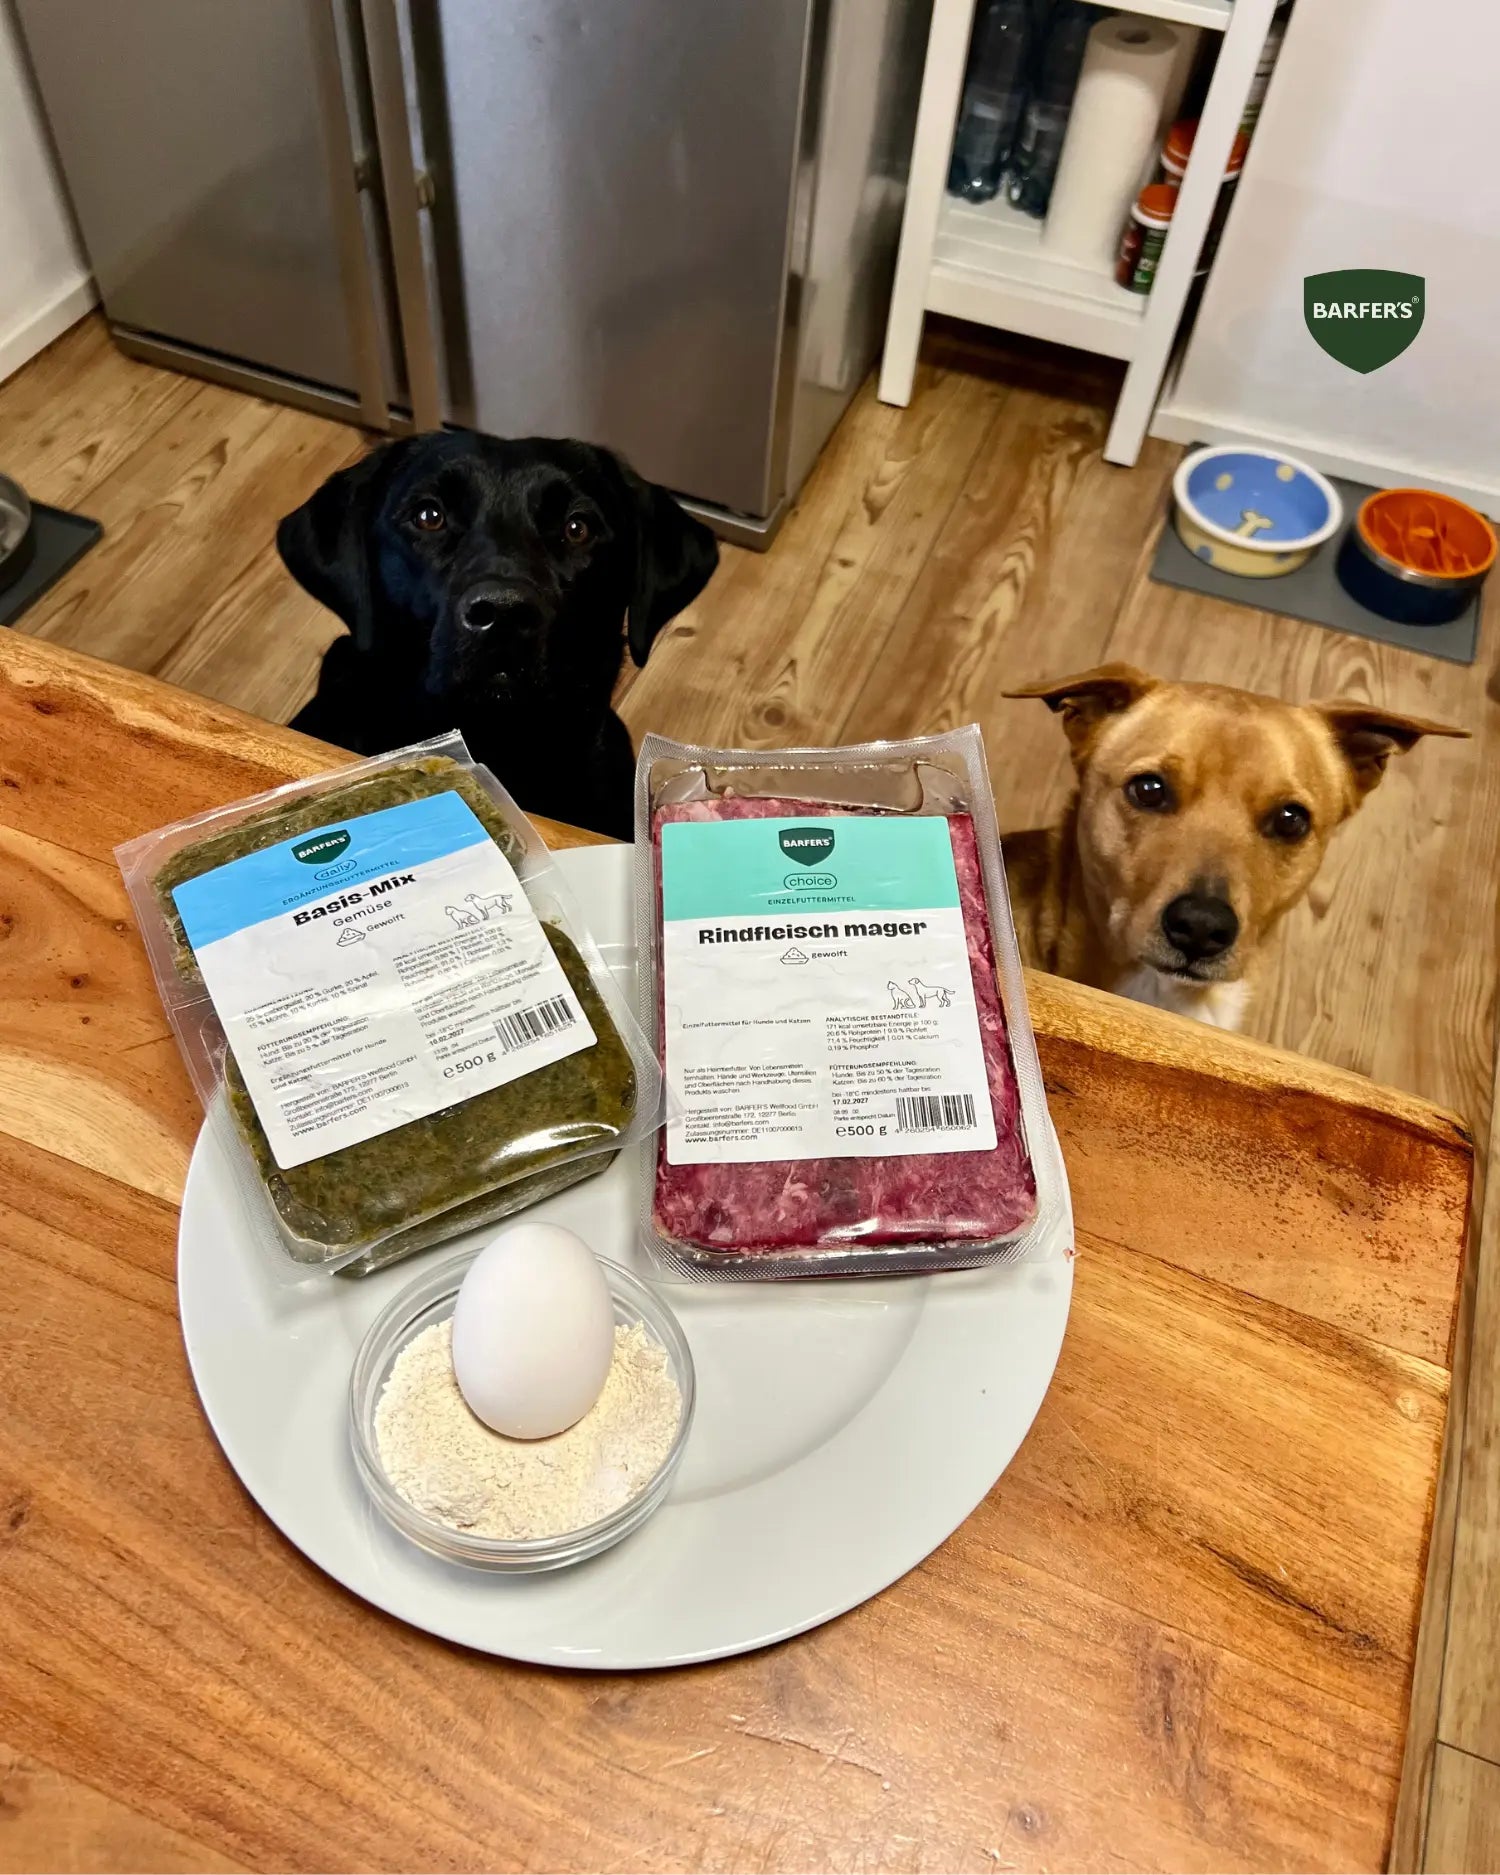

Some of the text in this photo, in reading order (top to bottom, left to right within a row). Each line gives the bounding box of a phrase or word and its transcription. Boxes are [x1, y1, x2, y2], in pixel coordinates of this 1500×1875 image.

[298, 837, 346, 859] BARFER'S
[783, 838, 830, 848] BARFER'S
[318, 862, 353, 882] daily
[789, 876, 832, 887] choice
[294, 875, 415, 926] Basis-Mix
[768, 896, 856, 905] EINZELFUTTERMITTEL
[332, 900, 392, 927] Gemüse
[366, 914, 405, 932] Gewolft
[698, 922, 928, 944] Rindfleisch mager
[811, 950, 848, 959] gewolft
[826, 1015, 869, 1023] ANALYTISCHE
[429, 1028, 465, 1046] 10.02.2027
[832, 1098, 869, 1106] 17.02.2027
[879, 1125, 887, 1136] g
[685, 1134, 758, 1143] www.barfers.com
